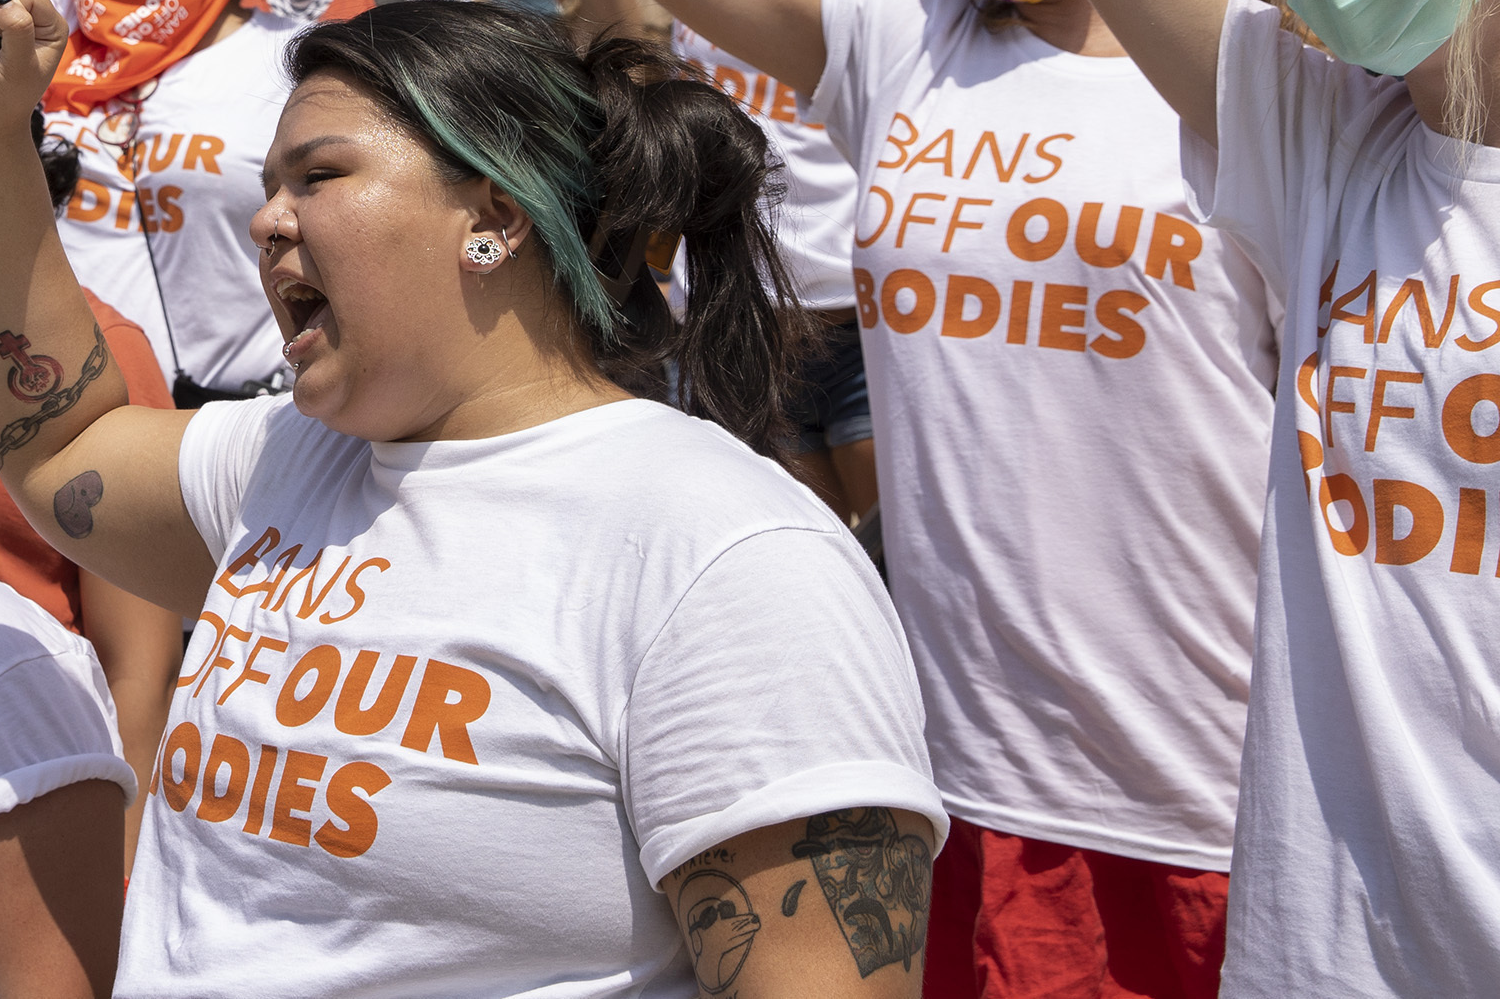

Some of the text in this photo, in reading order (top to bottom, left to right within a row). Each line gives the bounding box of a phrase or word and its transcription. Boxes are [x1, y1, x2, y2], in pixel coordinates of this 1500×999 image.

[877, 112, 1076, 184] BANS
[66, 178, 186, 234] DIES
[854, 185, 1204, 292] OFF OUR
[852, 267, 1150, 360] BODIES
[215, 526, 391, 625] BANS
[275, 643, 492, 766] OUR
[149, 720, 393, 859] ODIES
